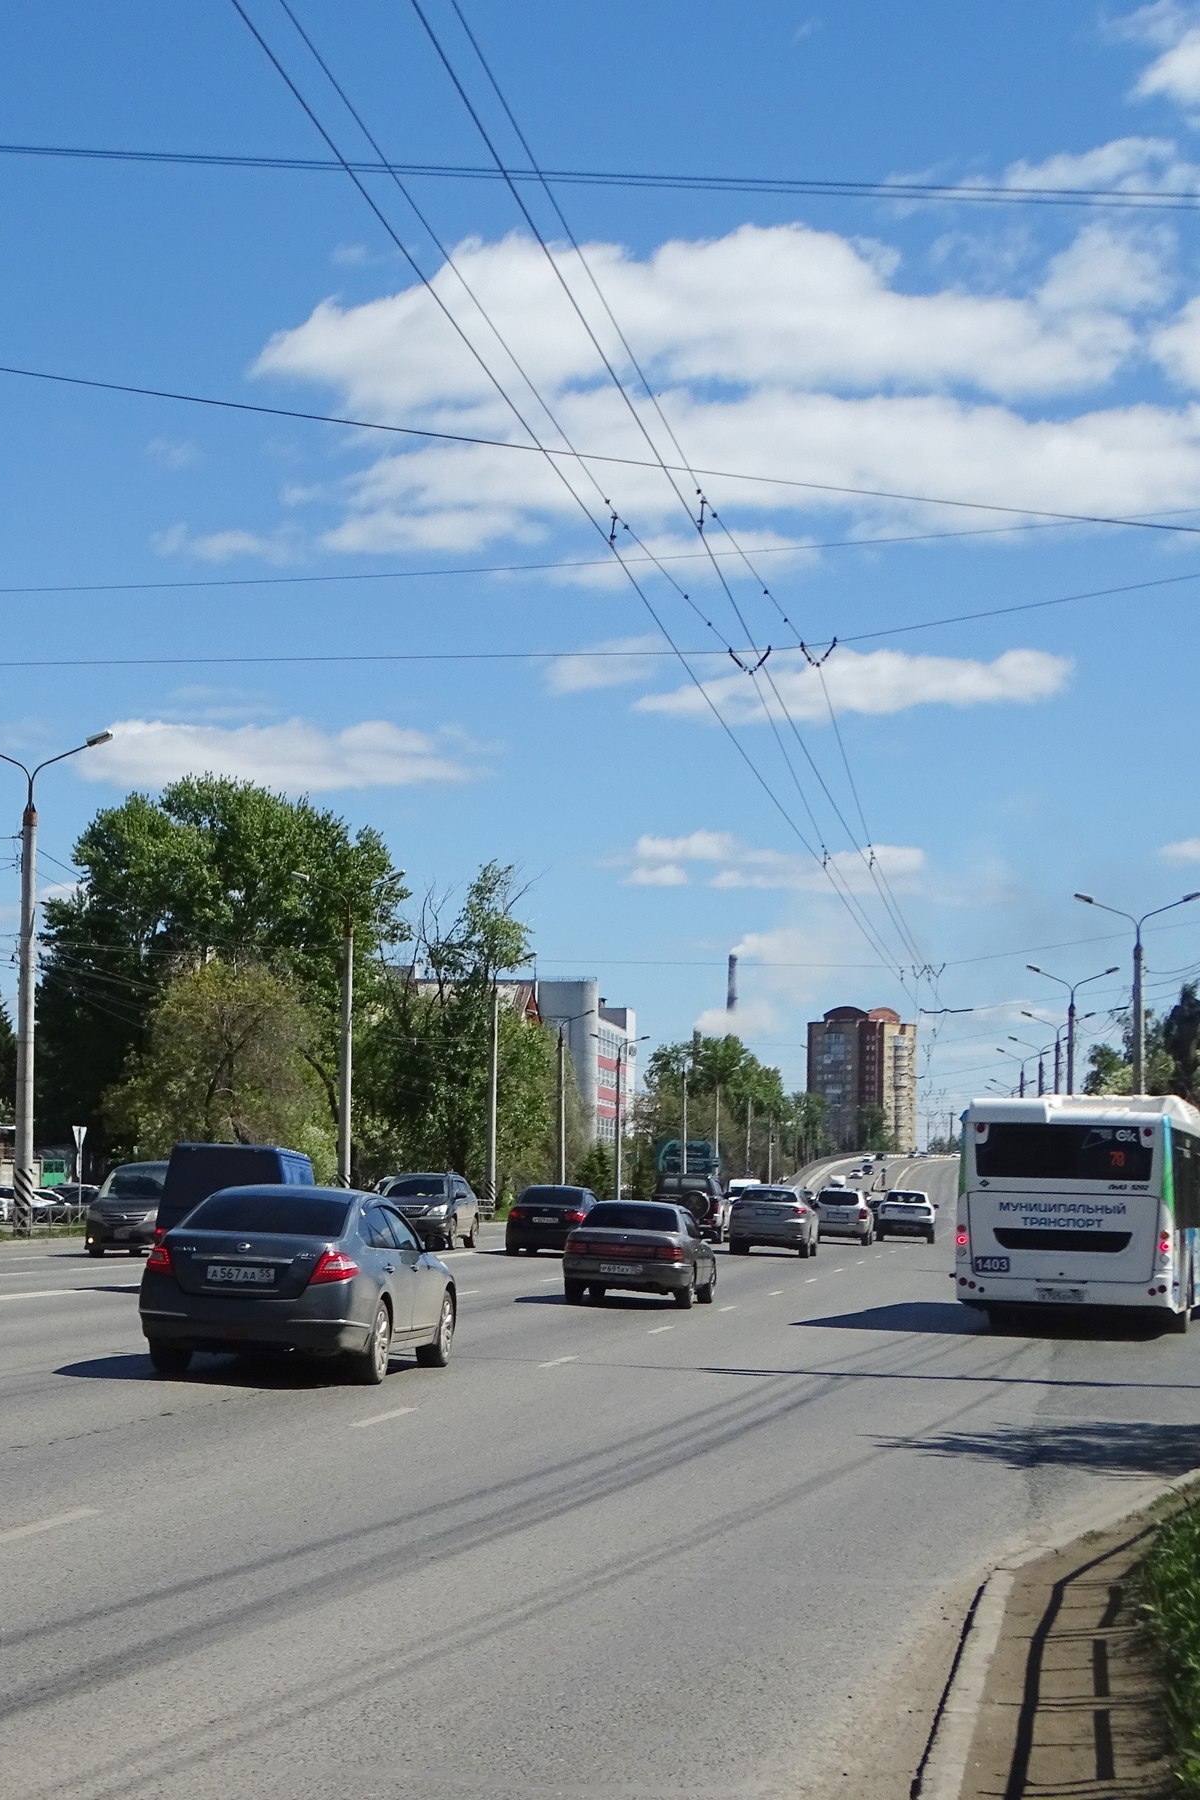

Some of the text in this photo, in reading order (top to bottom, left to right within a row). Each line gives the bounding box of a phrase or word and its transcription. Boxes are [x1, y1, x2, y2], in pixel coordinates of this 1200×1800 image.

[999, 1202, 1127, 1215] МУНИЦИПАЛЬНЫЙ
[1022, 1216, 1104, 1229] ТРАНСПОРТ
[976, 1259, 1008, 1271] 1403
